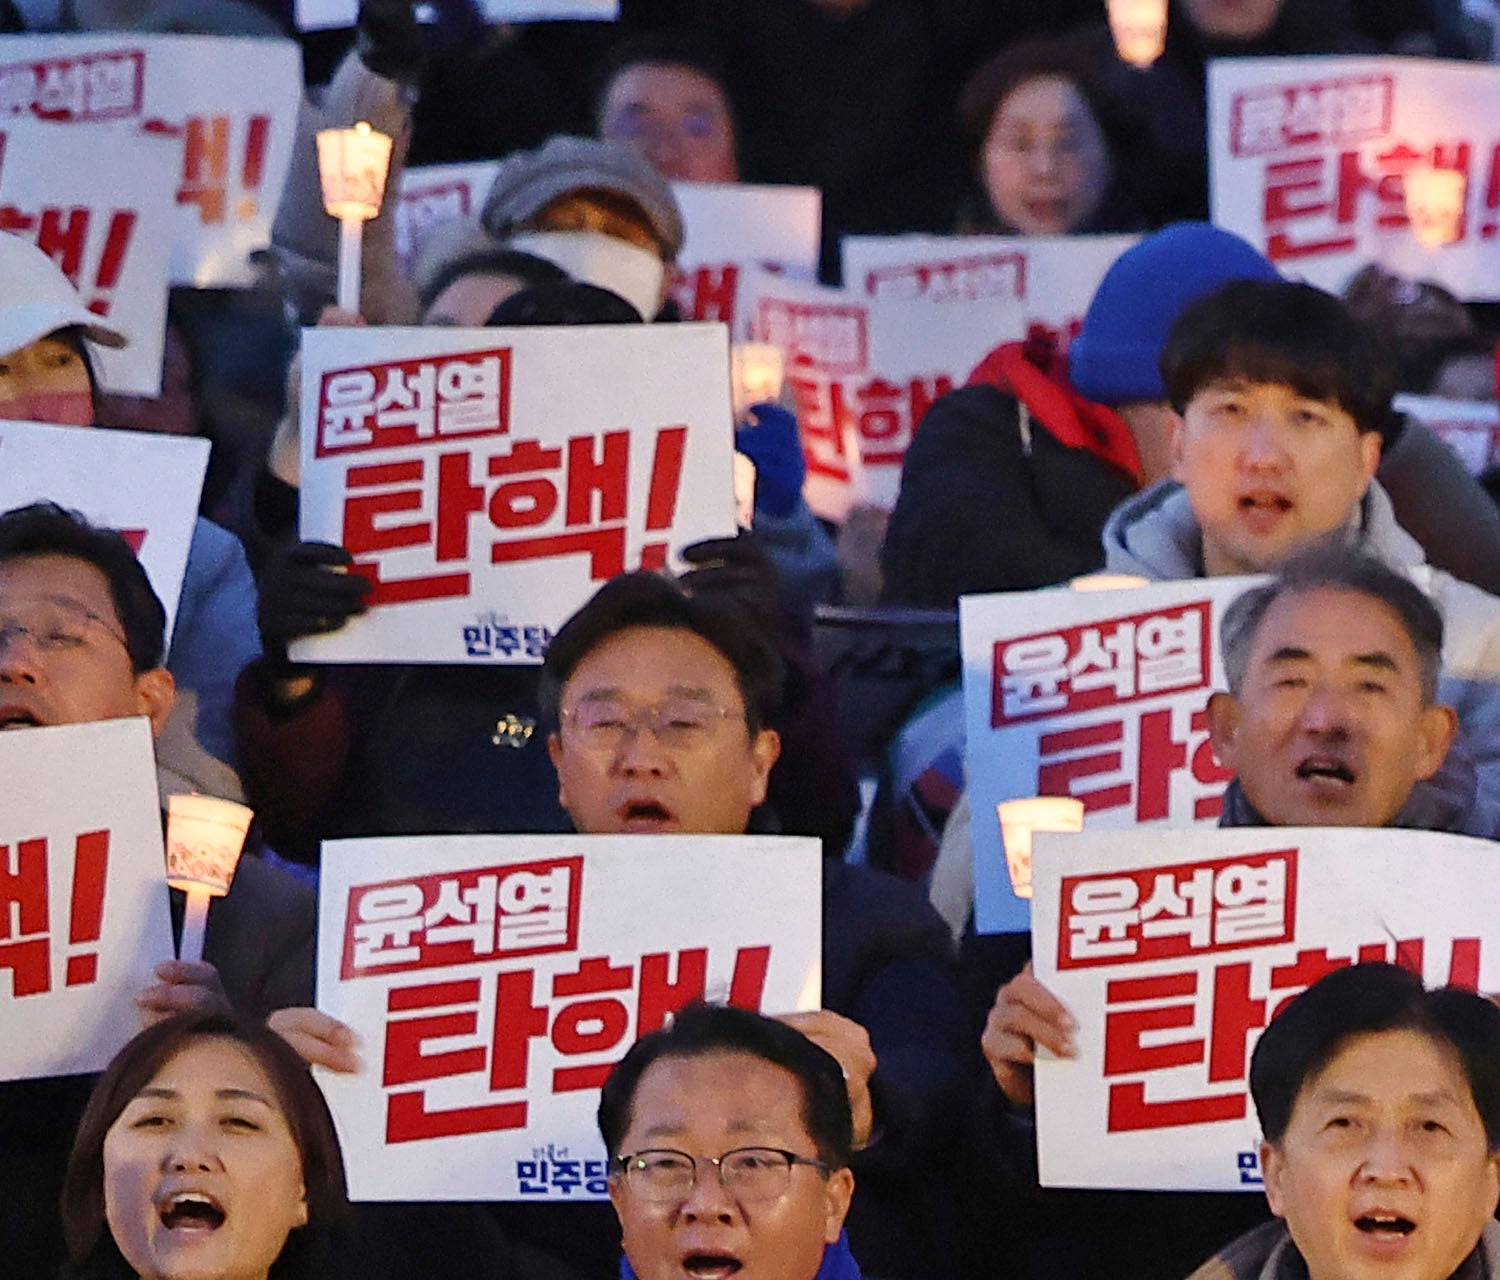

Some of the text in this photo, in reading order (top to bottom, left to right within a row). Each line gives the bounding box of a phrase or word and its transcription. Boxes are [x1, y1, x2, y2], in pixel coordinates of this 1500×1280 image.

[322, 355, 502, 447] 윤석열
[344, 426, 688, 605] 탄핵!
[1002, 616, 1203, 720] 윤석열
[353, 871, 570, 965] 윤석열
[1068, 861, 1284, 959] 윤석열
